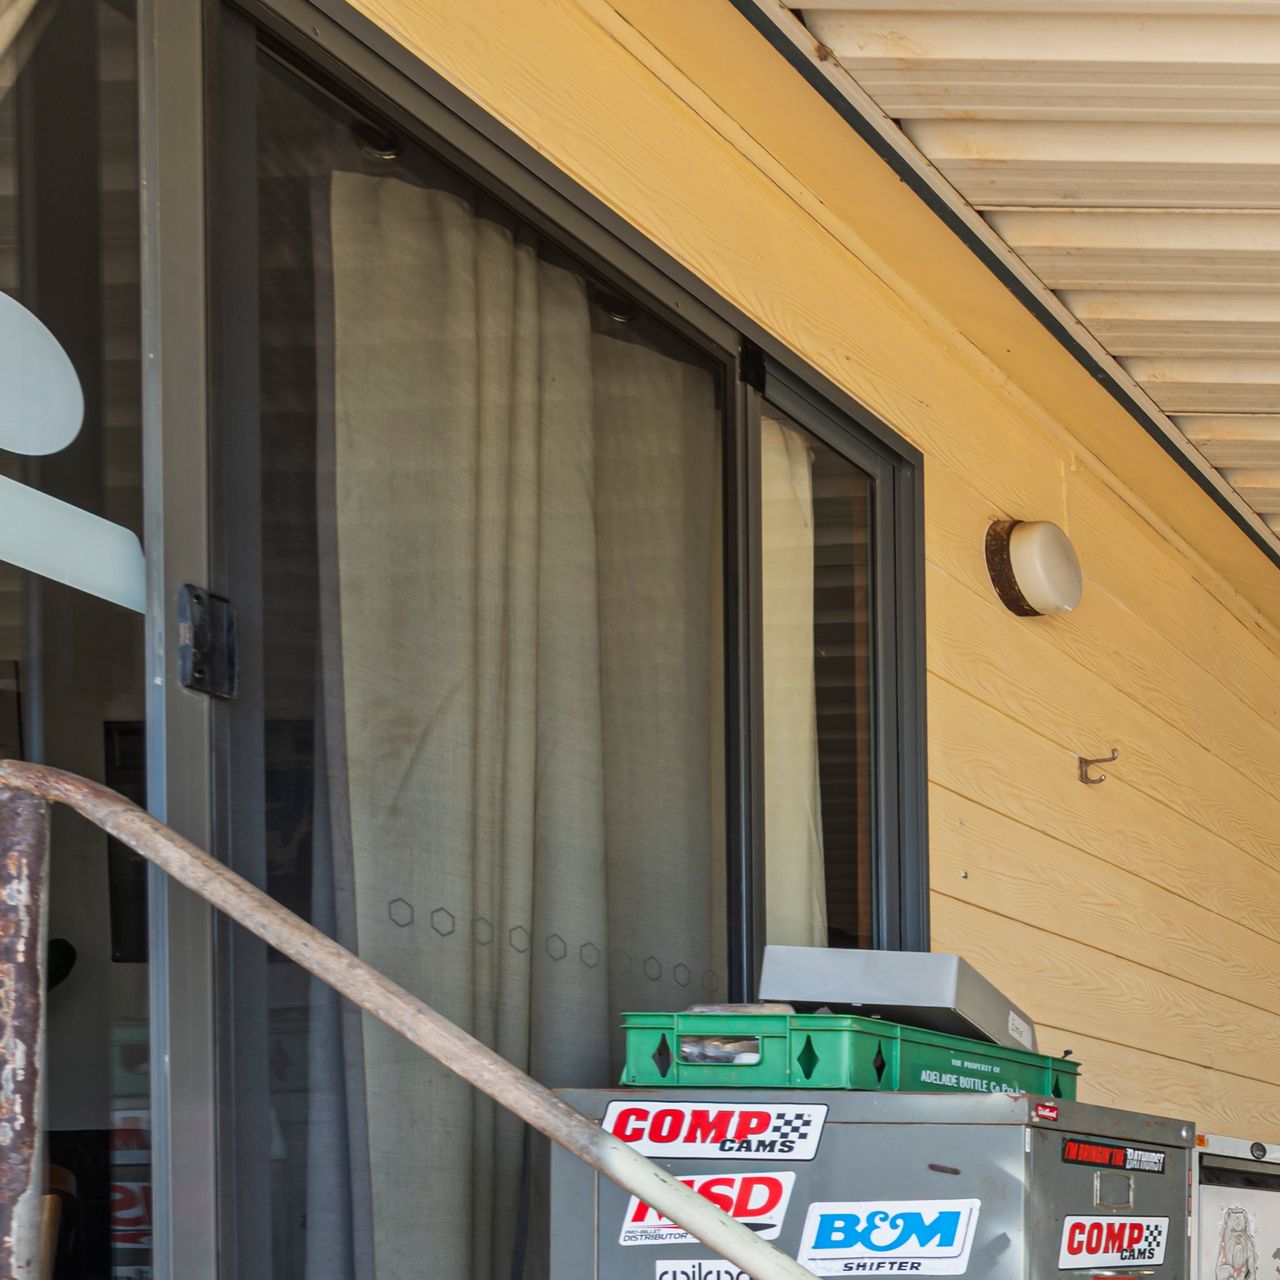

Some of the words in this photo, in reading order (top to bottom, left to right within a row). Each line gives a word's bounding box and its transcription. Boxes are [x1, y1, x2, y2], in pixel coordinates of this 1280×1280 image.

[920, 1069, 958, 1088] ADELAIDE
[959, 1076, 988, 1093] BOTTLE
[612, 1107, 771, 1144] COMP
[719, 1138, 796, 1154] CAMS
[623, 1232, 688, 1242] DISTRIBUTOR
[811, 1211, 962, 1252] B&M
[1067, 1222, 1144, 1255] COMP
[1120, 1248, 1155, 1261] CAMS
[843, 1261, 922, 1272] SHIFTER
